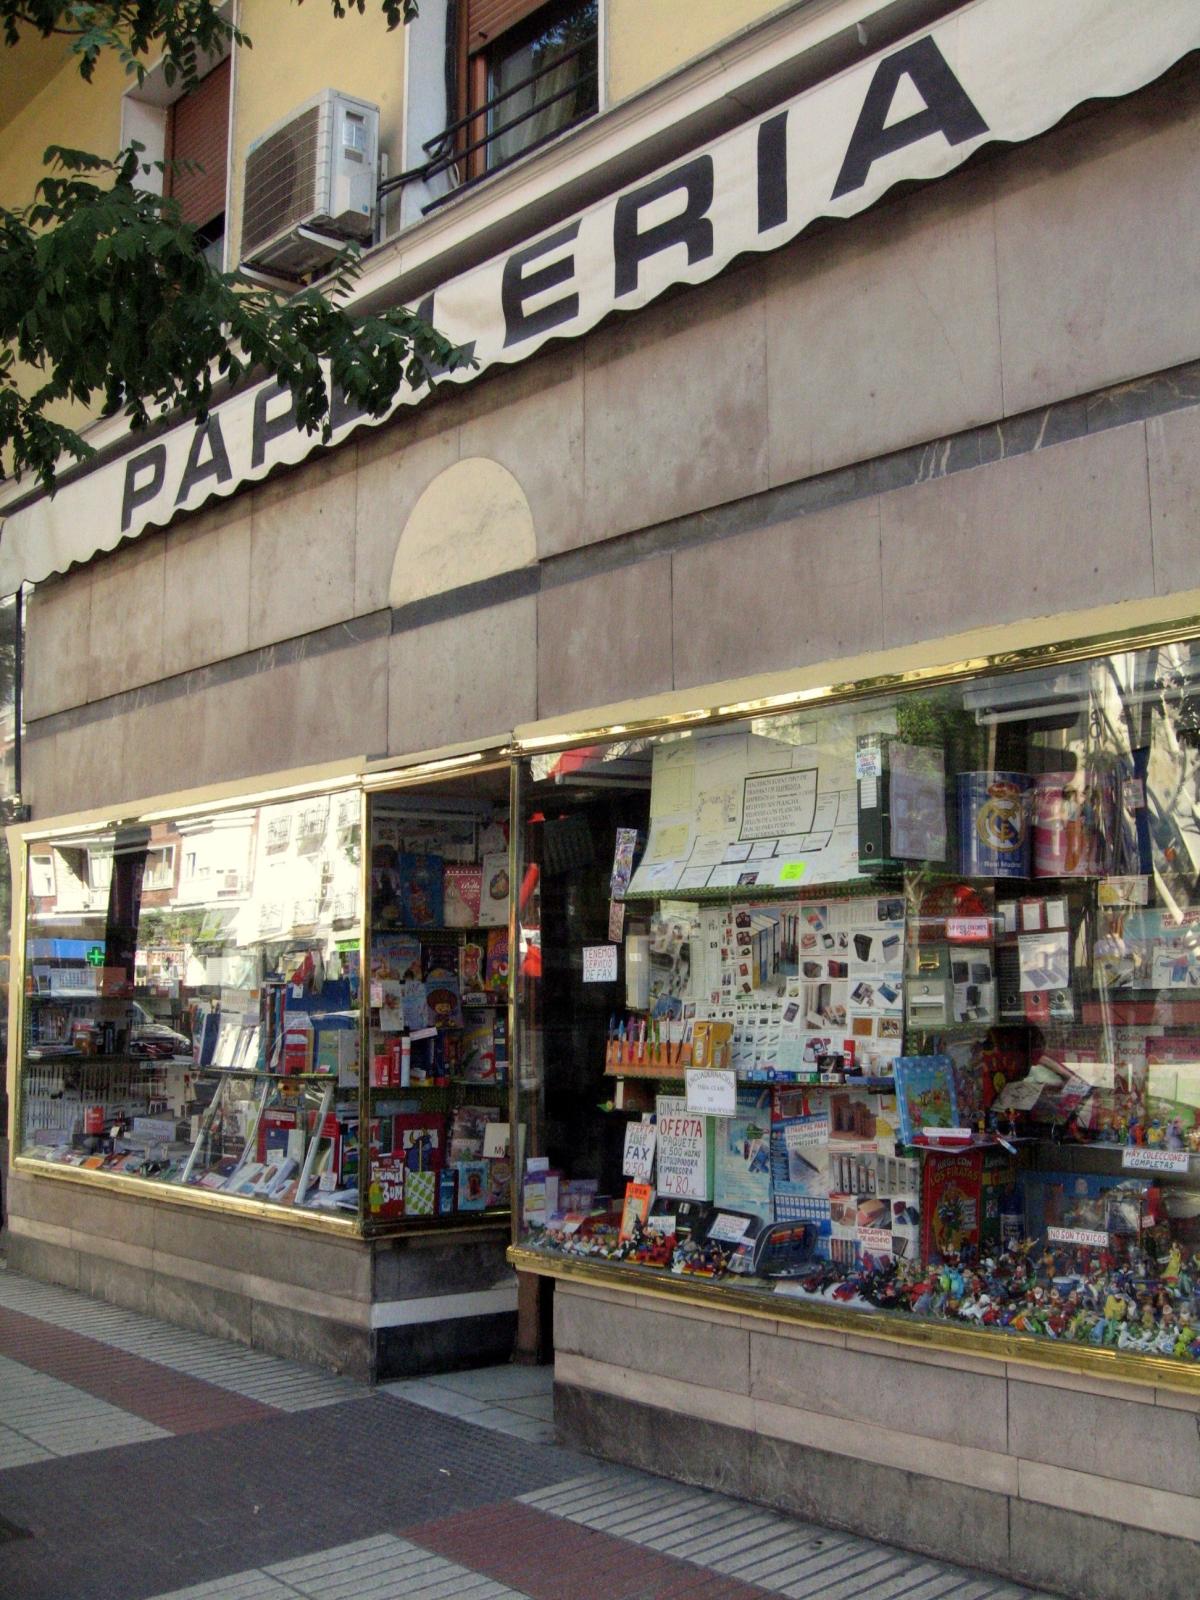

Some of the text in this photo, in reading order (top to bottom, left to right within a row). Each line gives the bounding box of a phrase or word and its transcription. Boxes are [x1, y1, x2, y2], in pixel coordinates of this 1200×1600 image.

[121, 34, 990, 533] PAPLERIA
[584, 948, 616, 959] TENEMOS
[585, 969, 613, 980] DE FAX
[660, 1119, 703, 1138] OFERTA
[662, 1136, 698, 1149] PAQUETE
[625, 1145, 650, 1161] FAX
[669, 1146, 683, 1157] 500
[1125, 1150, 1187, 1163] HAY COLECCIONES
[1130, 1158, 1175, 1169] COMPLETAS
[1050, 1230, 1107, 1245] NO SON TOXICOS
